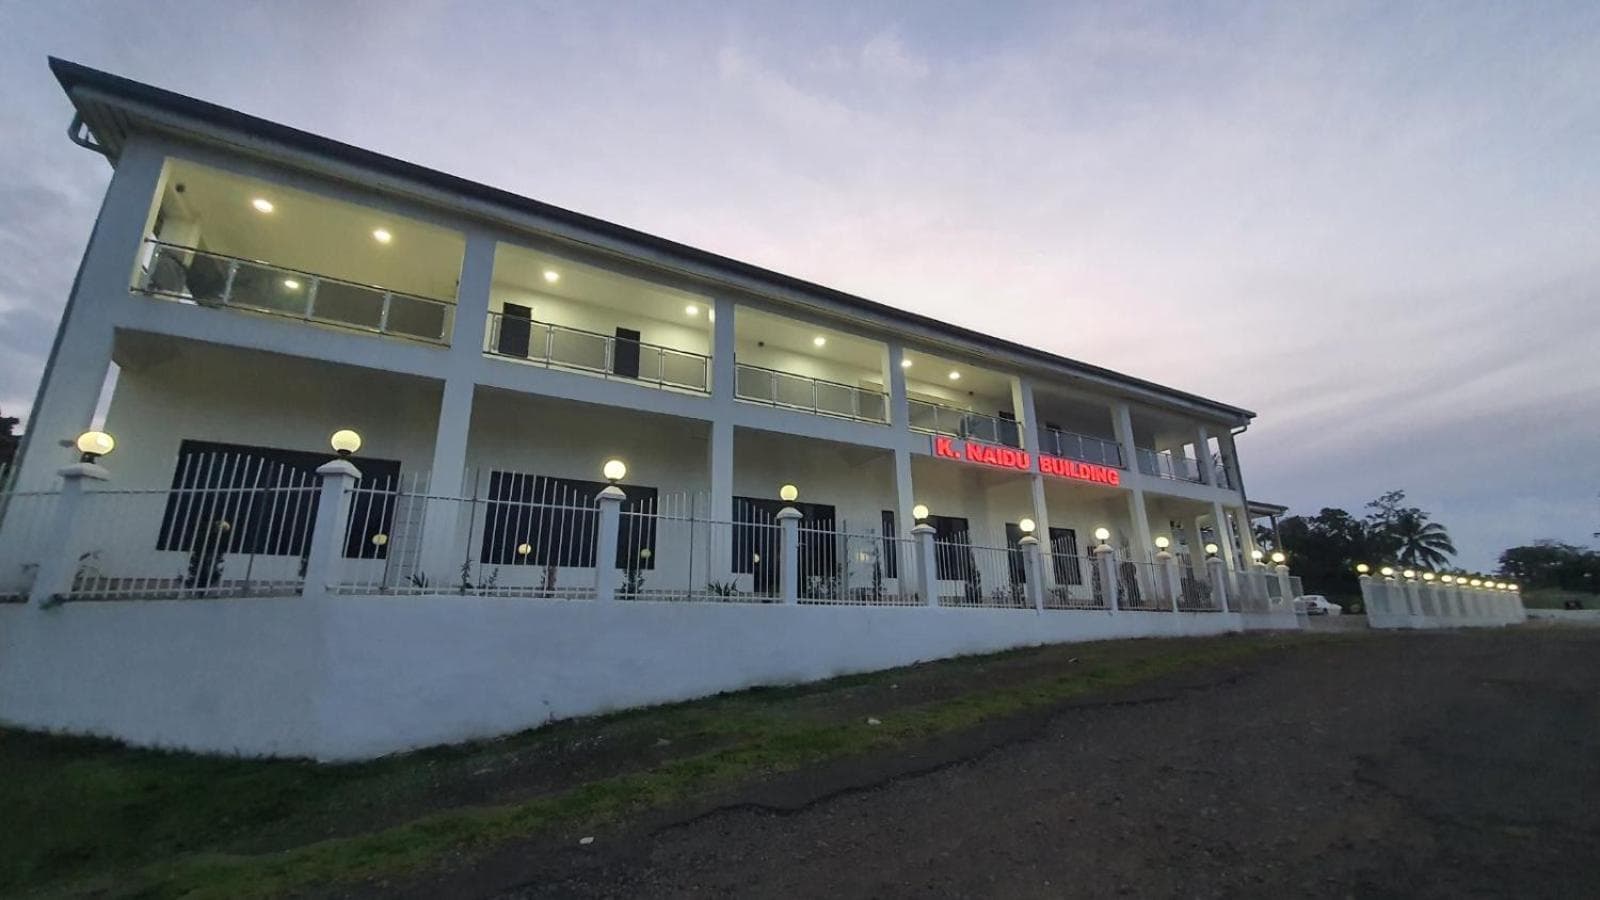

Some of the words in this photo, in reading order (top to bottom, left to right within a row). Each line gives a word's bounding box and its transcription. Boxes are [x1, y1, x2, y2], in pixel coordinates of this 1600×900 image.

[936, 435, 961, 458] K.
[966, 442, 1031, 470] NAIDU
[1039, 455, 1120, 486] BUILDING
